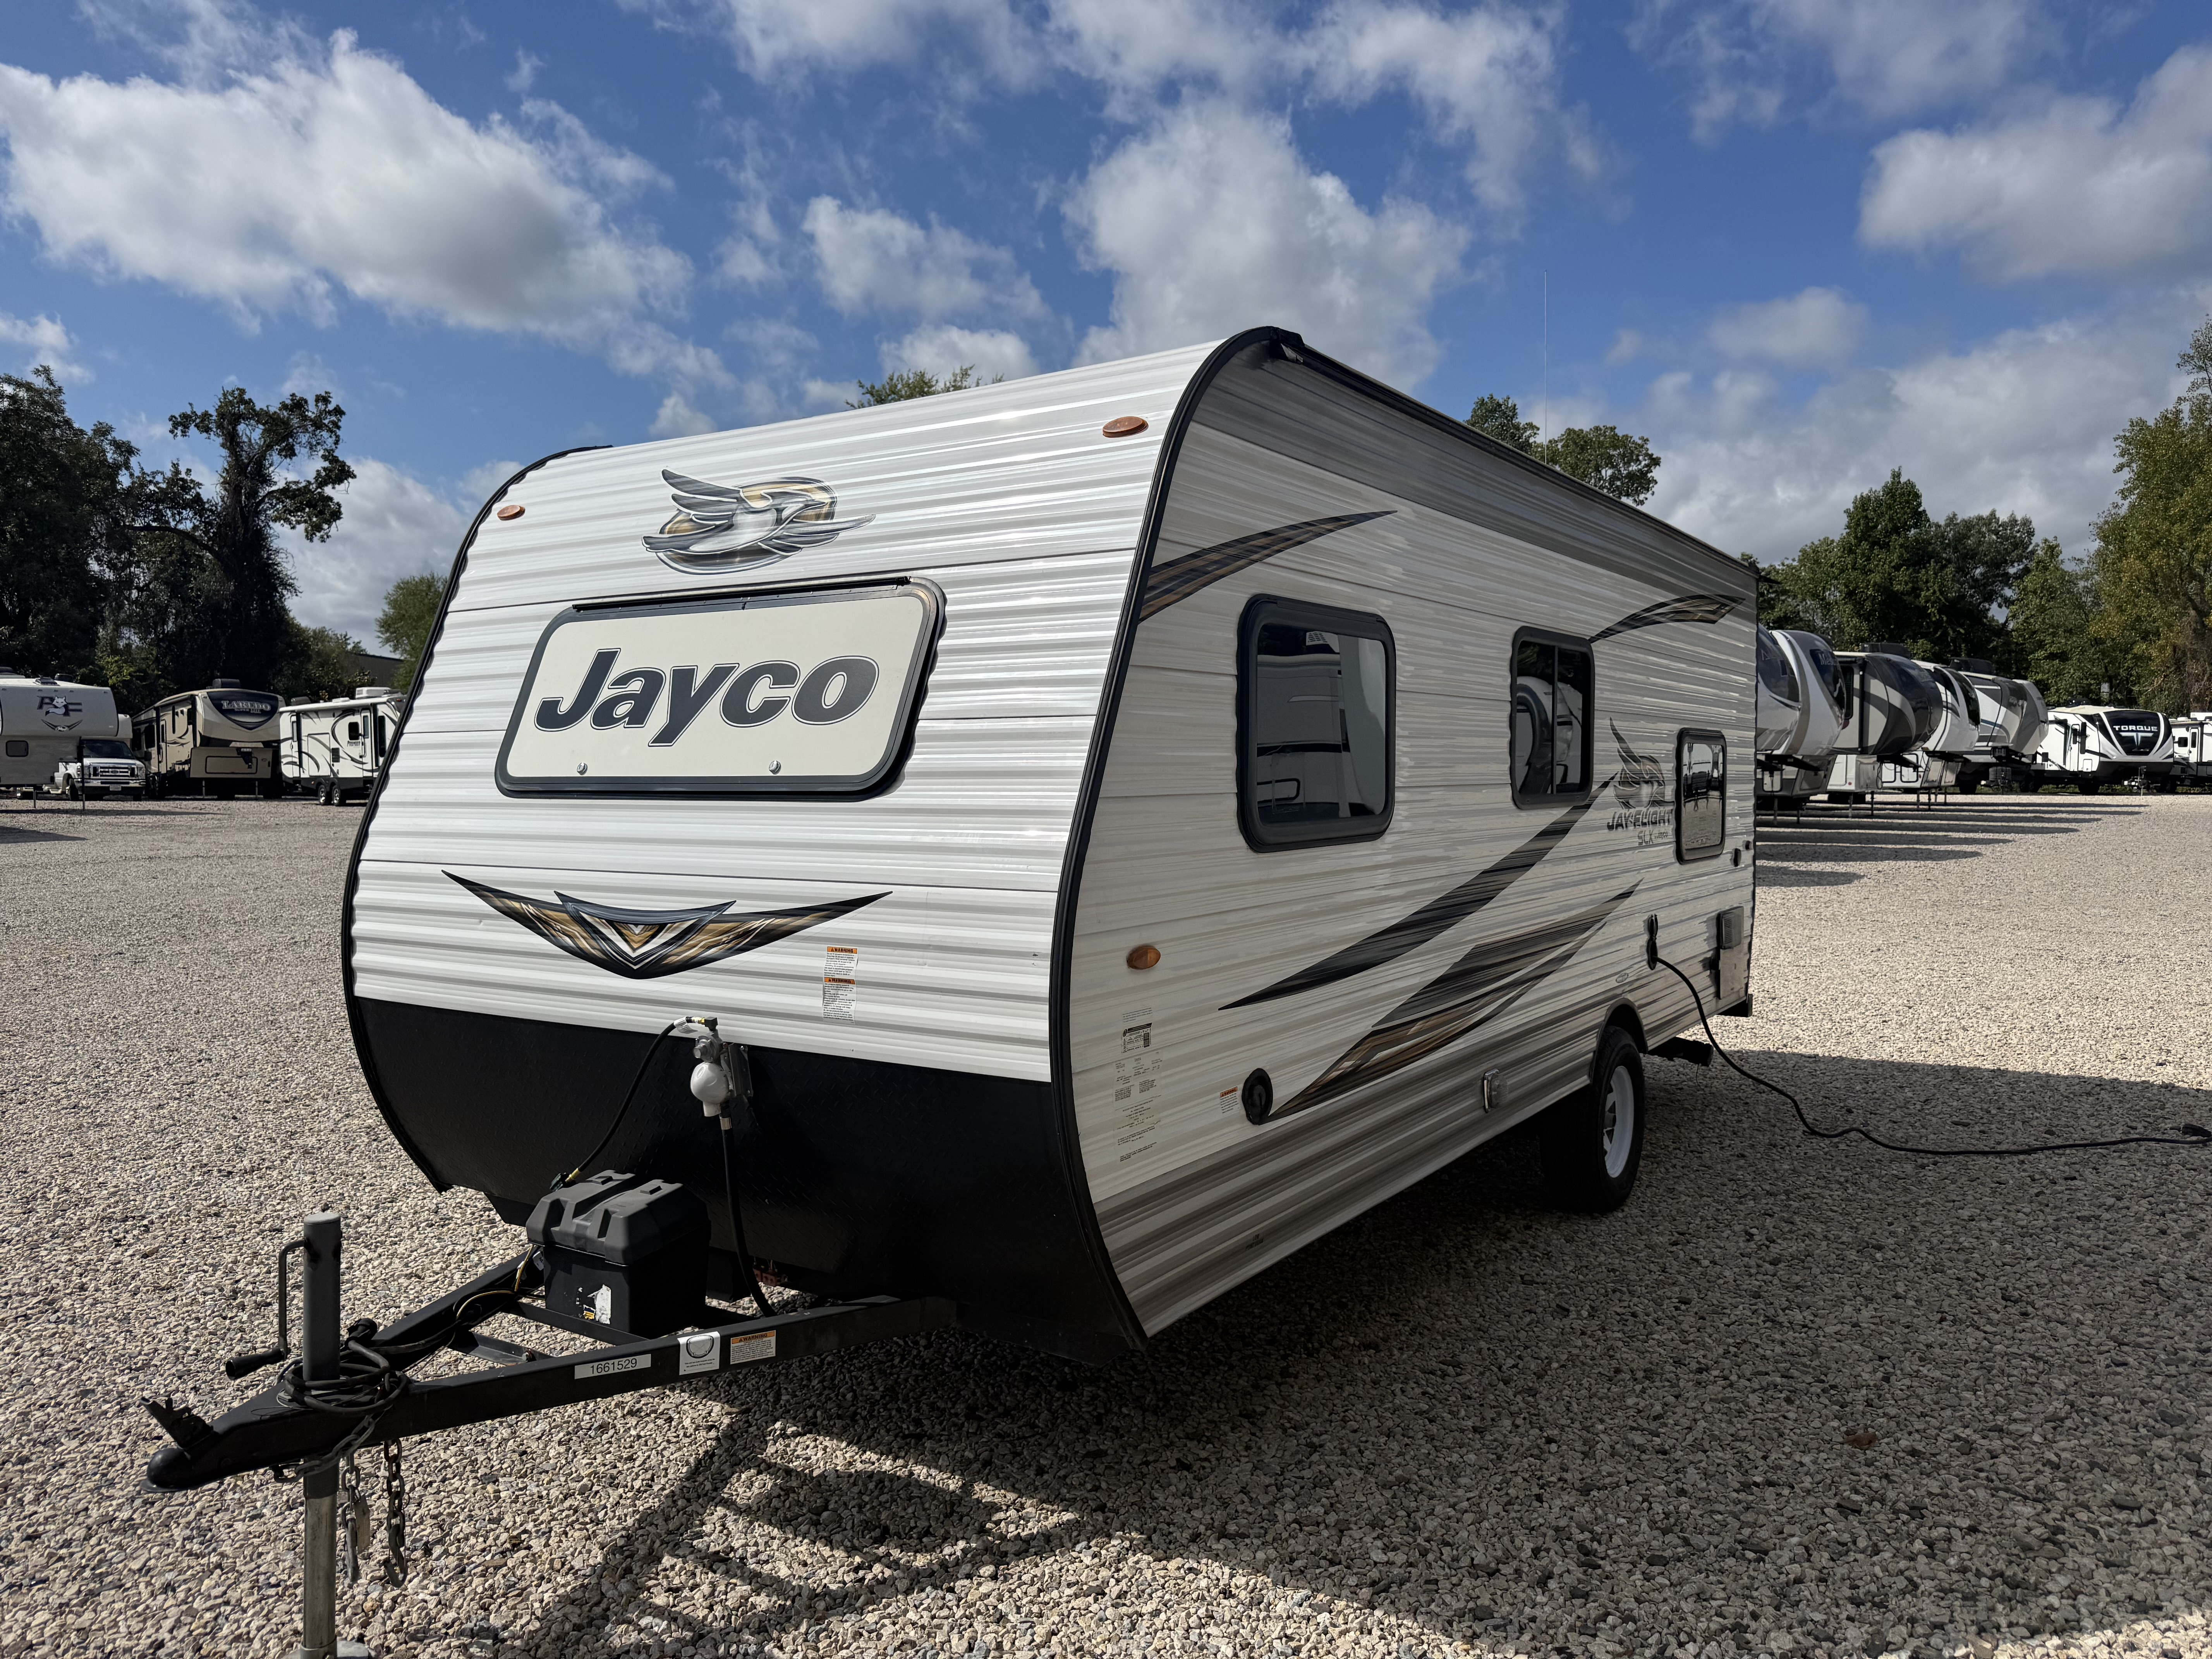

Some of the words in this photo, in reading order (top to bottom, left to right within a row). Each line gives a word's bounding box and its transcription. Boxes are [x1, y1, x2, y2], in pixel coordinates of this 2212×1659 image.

[534, 648, 879, 747] Jayco
[1638, 830, 1653, 846] SLX
[743, 1333, 768, 1341] WARNING
[591, 1358, 637, 1374] 1661529
